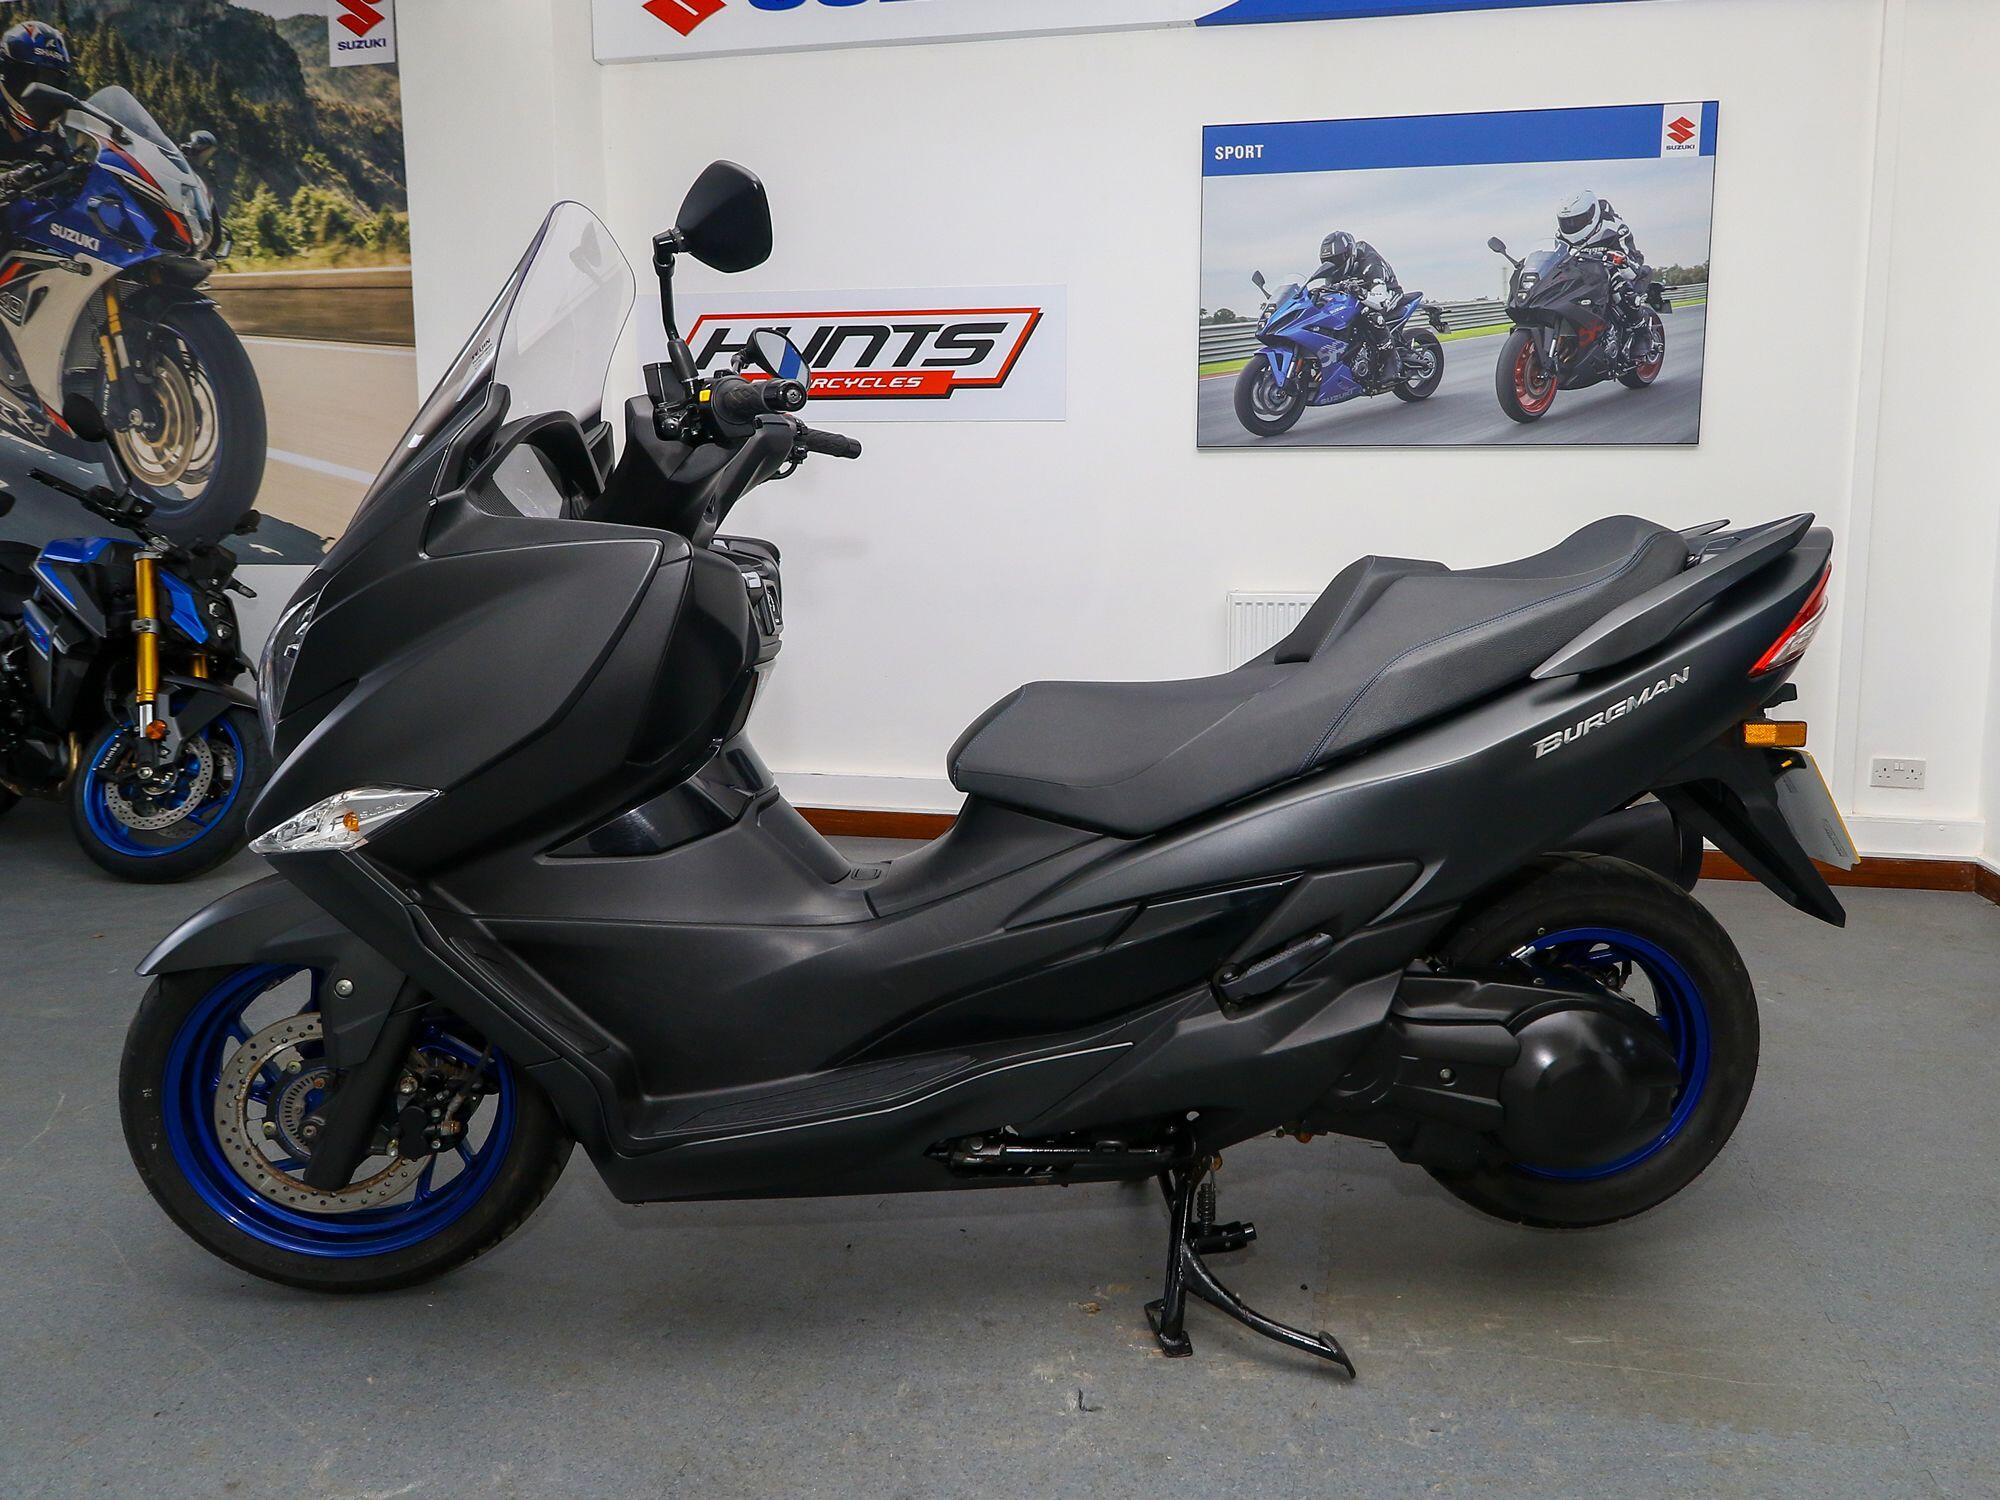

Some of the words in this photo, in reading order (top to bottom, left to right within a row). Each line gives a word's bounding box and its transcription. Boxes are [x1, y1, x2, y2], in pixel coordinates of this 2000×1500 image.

[337, 38, 387, 51] SUZUKI
[1214, 144, 1265, 160] SPORT
[49, 222, 100, 252] SUZUKI
[751, 376, 924, 390] RCYCLES
[1531, 666, 1690, 759] BURGMAN
[99, 742, 121, 769] brembo
